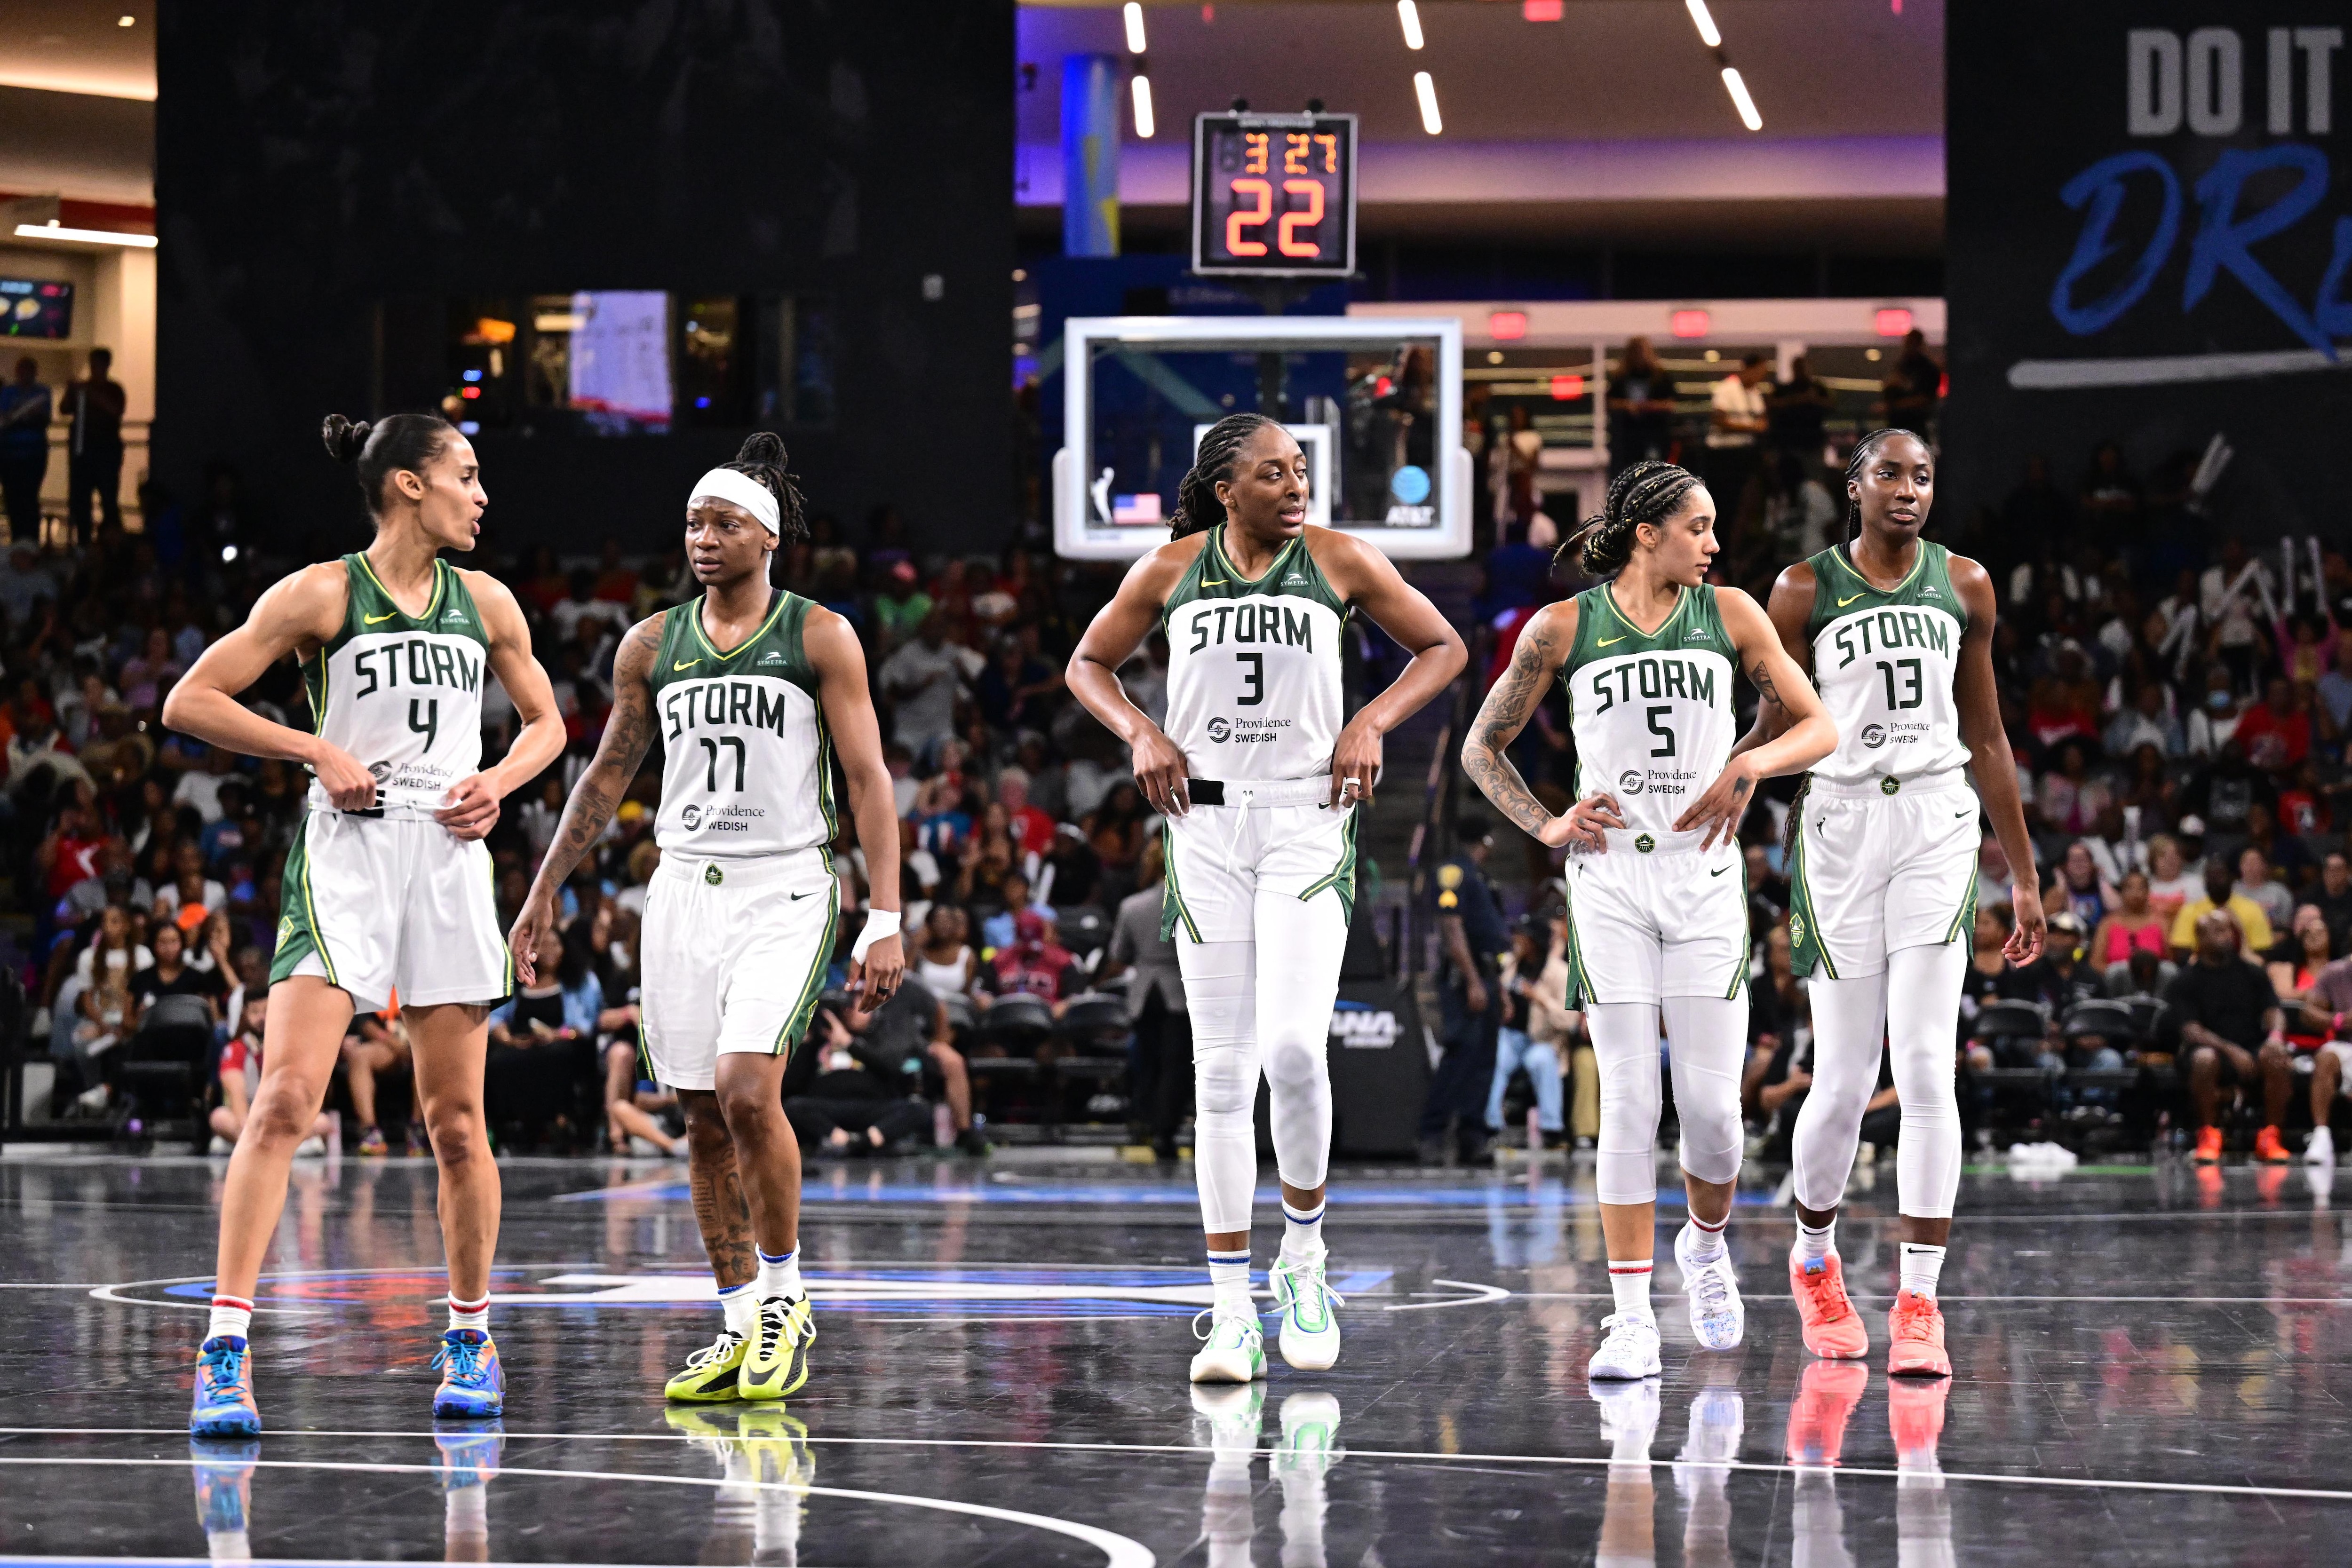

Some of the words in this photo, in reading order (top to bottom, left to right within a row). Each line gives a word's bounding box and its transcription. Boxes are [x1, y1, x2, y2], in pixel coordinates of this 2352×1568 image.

[2127, 27, 2243, 137] DO
[2267, 27, 2343, 135] IT
[1226, 178, 1325, 257] 22
[1190, 603, 1312, 655] STORM
[1835, 611, 1948, 670] STORM
[355, 639, 478, 703] STORM
[1236, 652, 1264, 705] 3
[1593, 658, 1714, 716] STORM
[1876, 658, 1922, 711] 13
[407, 698, 437, 753] 4
[667, 682, 785, 743] STORM
[1235, 717, 1291, 729] Providence
[1235, 733, 1277, 743] SWEDISH
[1646, 705, 1676, 758] 5
[1890, 720, 1931, 732] Provience
[392, 777, 441, 790] SWEDISH
[699, 736, 745, 792] 17
[1647, 768, 1696, 780] Providence
[1648, 784, 1685, 794] SWEDISH
[704, 821, 748, 832] SWEDISH
[706, 805, 765, 817] Providence
